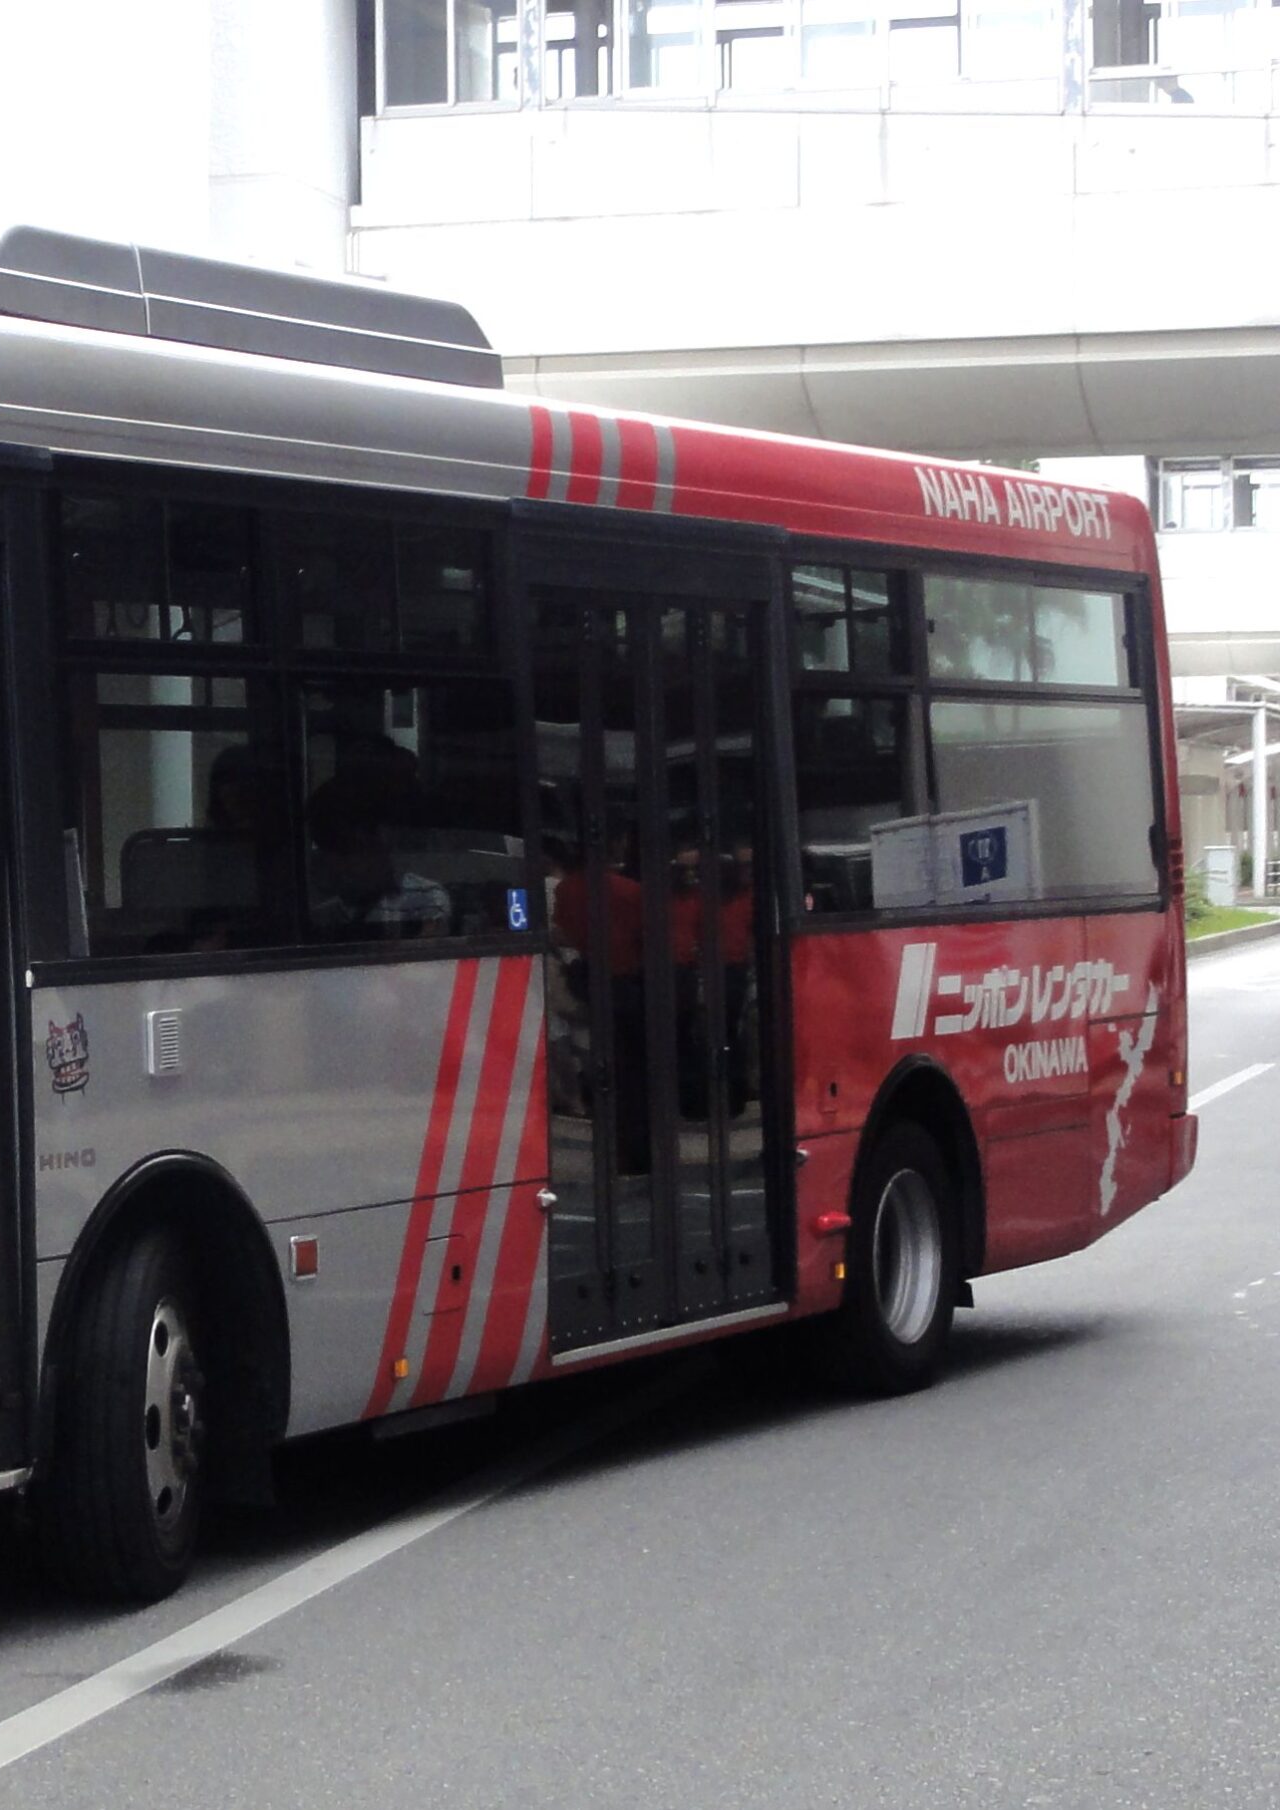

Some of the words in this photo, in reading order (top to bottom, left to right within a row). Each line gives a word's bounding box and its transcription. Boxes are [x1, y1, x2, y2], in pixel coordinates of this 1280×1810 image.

[914, 466, 1001, 525] NAHA
[1003, 480, 1111, 540] AIRPORT
[934, 958, 1131, 1036] ニッポンレンタカー
[1004, 1036, 1089, 1084] OKINAWA
[39, 1147, 97, 1172] HINO
